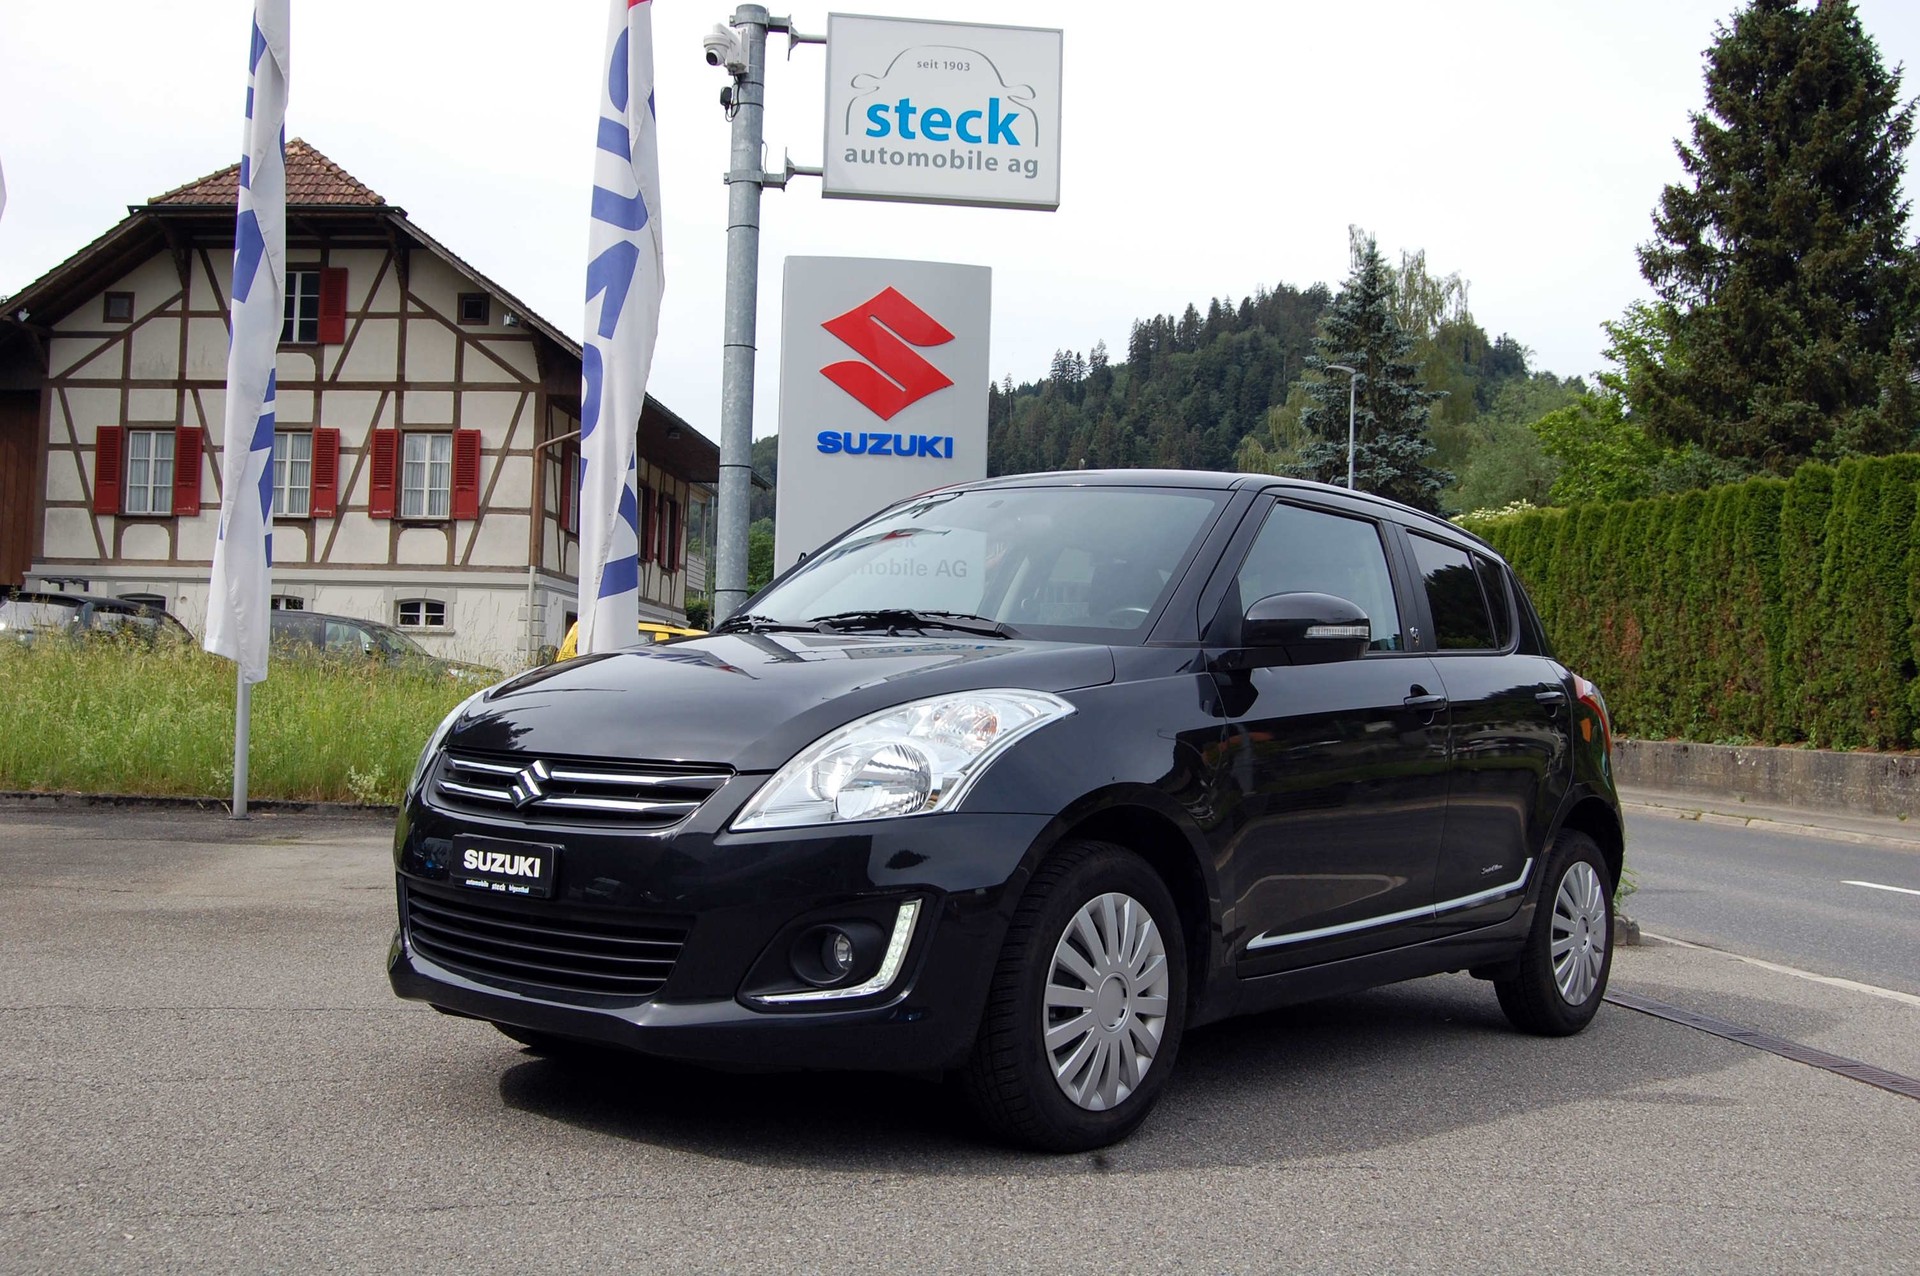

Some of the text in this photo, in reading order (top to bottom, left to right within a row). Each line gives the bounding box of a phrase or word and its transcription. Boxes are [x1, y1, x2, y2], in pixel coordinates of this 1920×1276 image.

[916, 59, 971, 72] seit 1903
[865, 97, 1021, 146] steck
[844, 147, 1039, 179] automobile ag
[816, 430, 954, 459] SUZUKI
[935, 560, 967, 578] AG
[463, 849, 541, 878] SUZUKI
